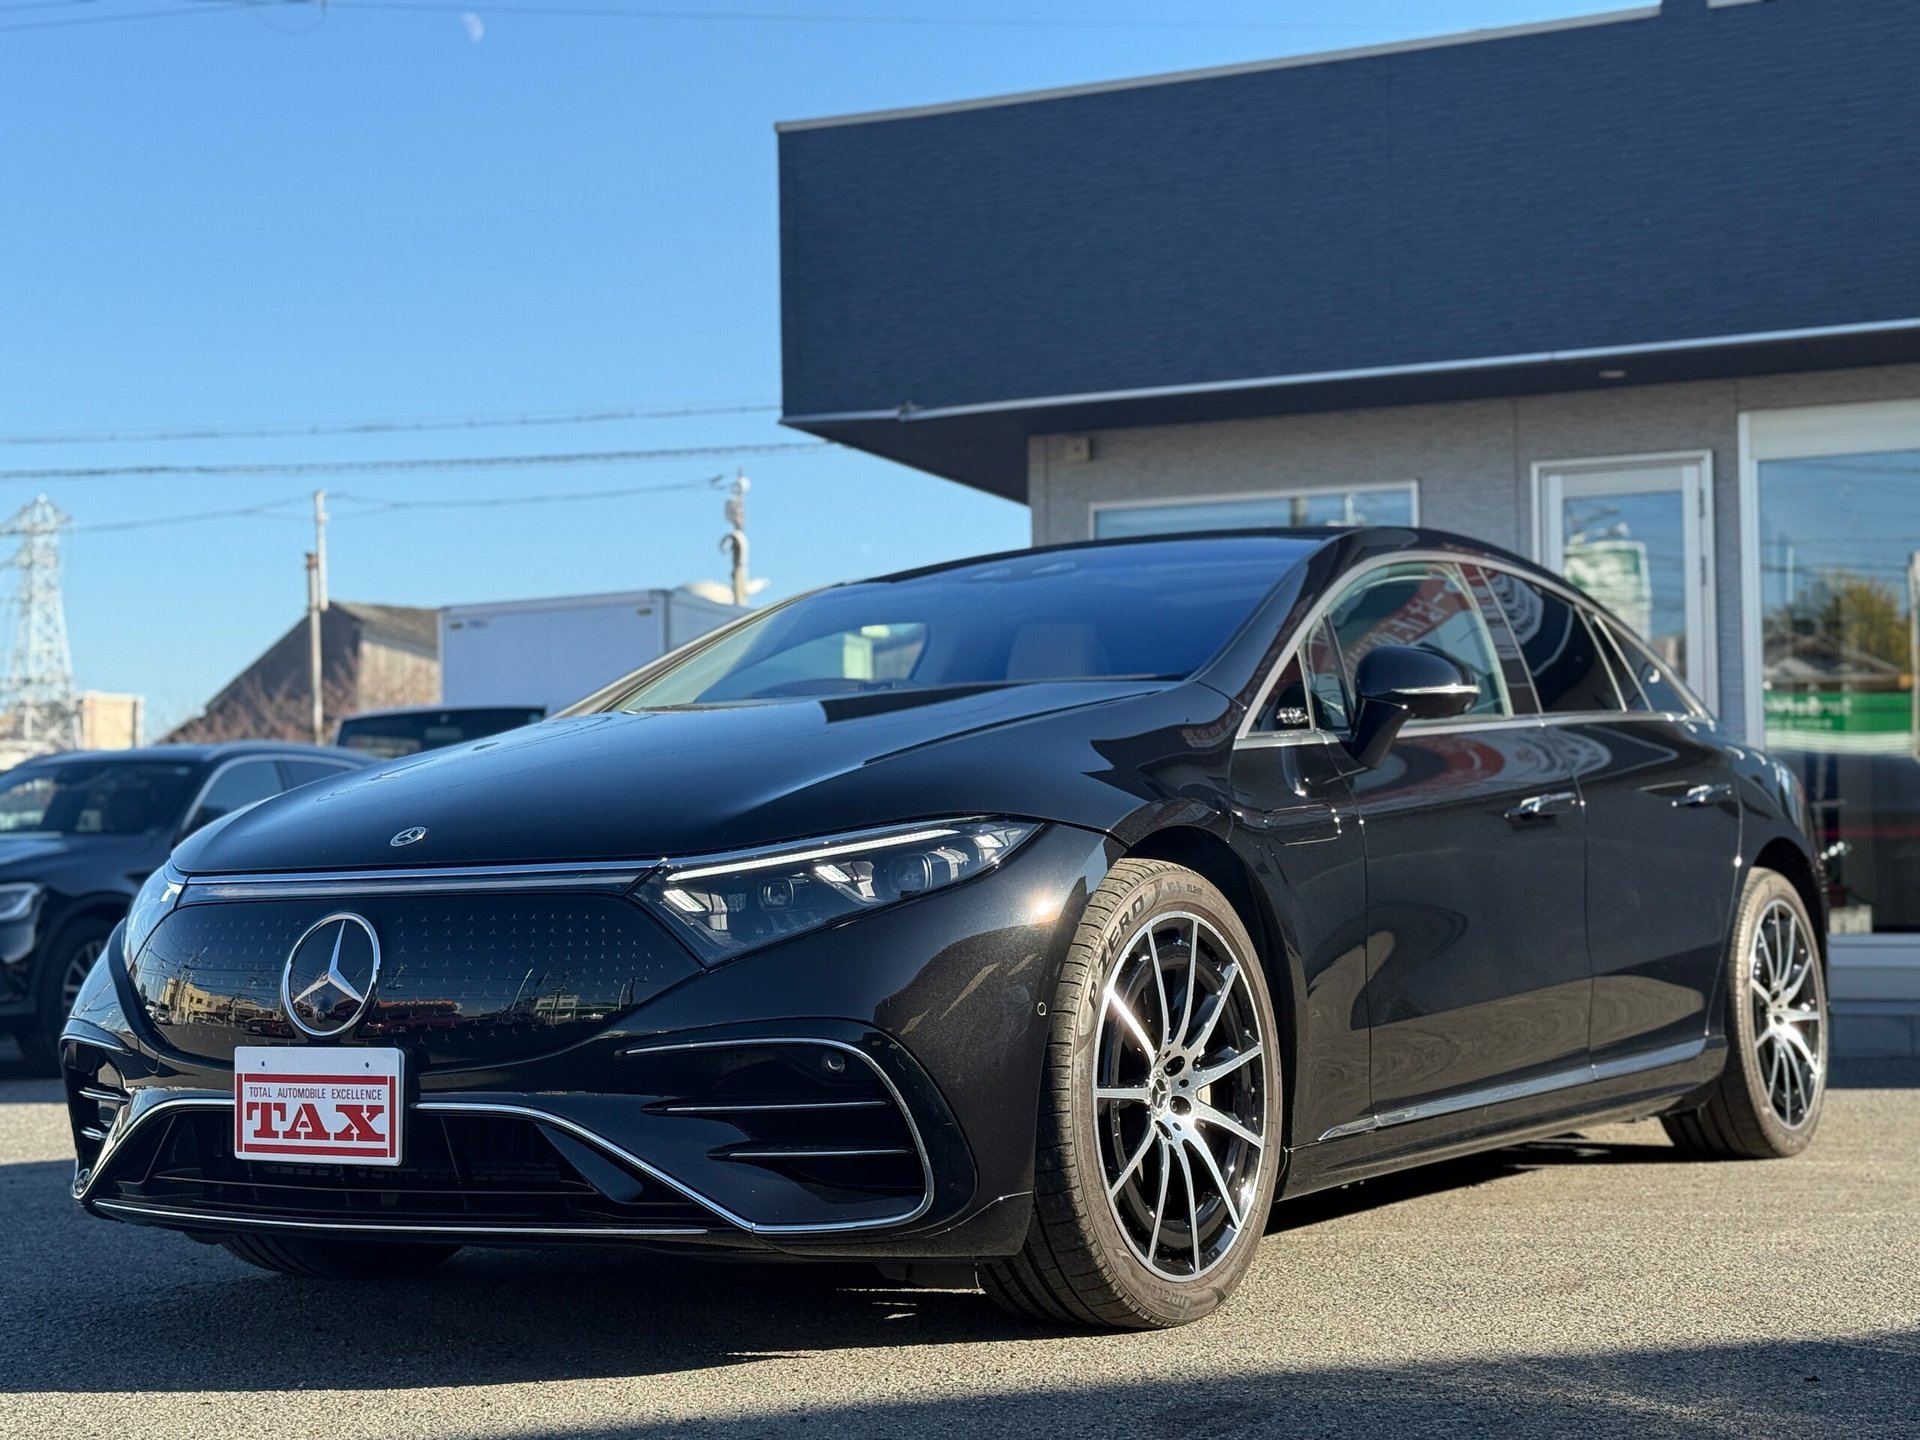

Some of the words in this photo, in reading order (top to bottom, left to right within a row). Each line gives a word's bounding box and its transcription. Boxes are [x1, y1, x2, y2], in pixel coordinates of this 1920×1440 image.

[1098, 894, 1145, 980] ZERO
[249, 1086, 272, 1098] TOTAL
[277, 1087, 326, 1099] AUTOMOBILE
[331, 1088, 382, 1100] EXCELLENCE
[246, 1102, 386, 1142] TAX
